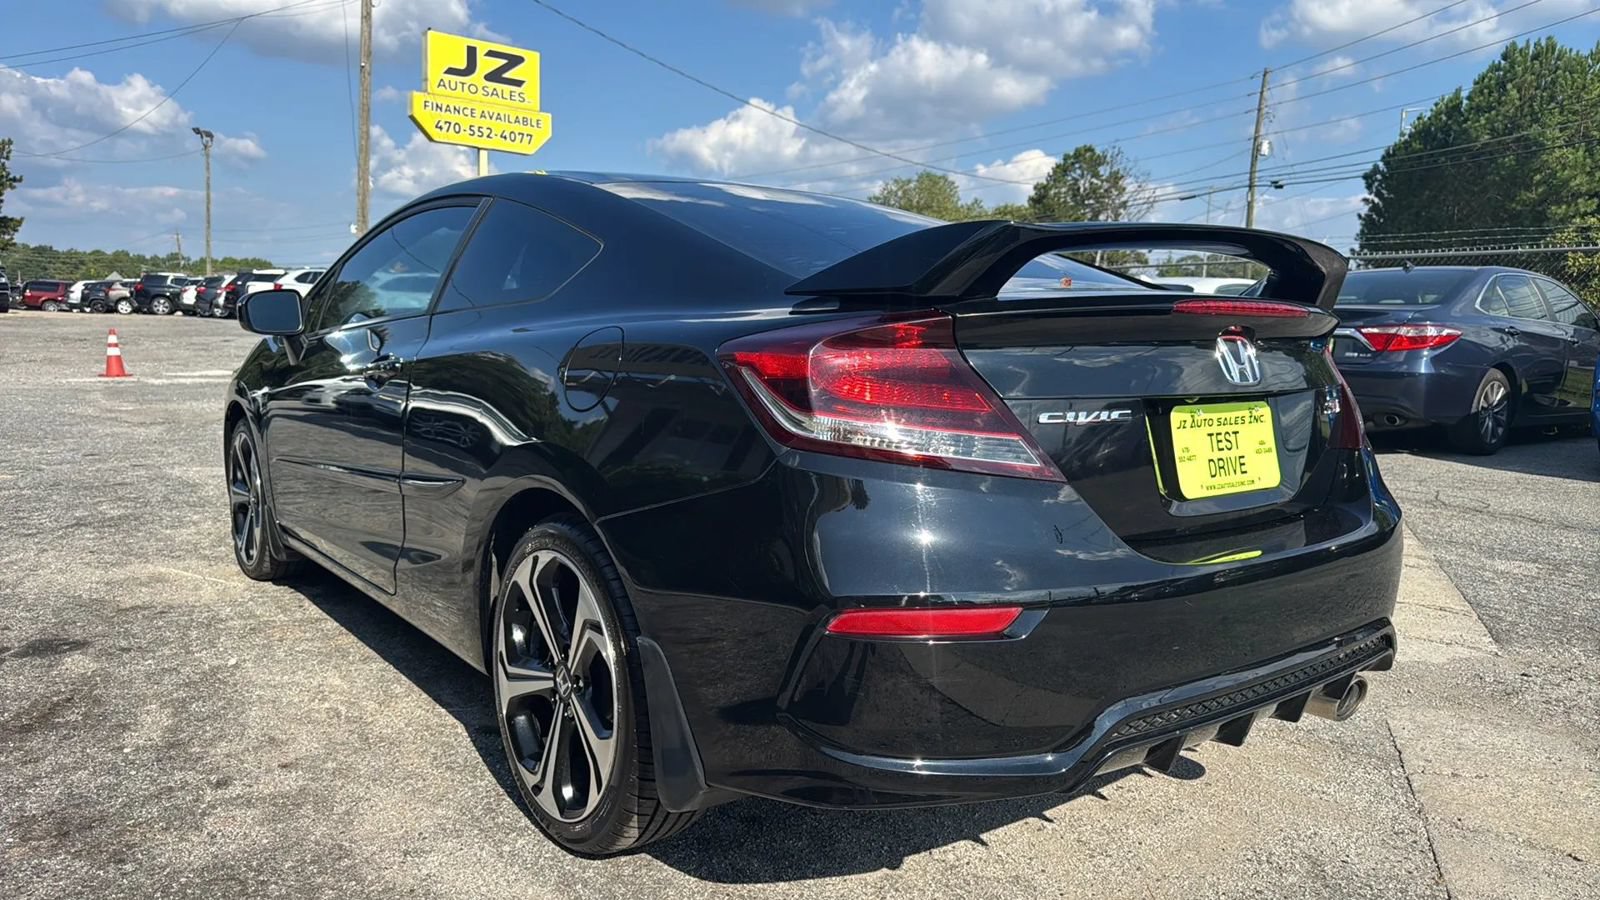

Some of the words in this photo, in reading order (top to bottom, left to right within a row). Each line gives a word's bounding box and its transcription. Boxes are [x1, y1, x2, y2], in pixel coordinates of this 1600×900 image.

[443, 45, 526, 88] JZ
[437, 78, 478, 95] AUTO
[481, 86, 526, 103] SALES
[423, 100, 476, 118] FINANCE
[480, 110, 542, 129] AVAILABLE
[435, 119, 533, 145] 470-552-4077
[1038, 410, 1132, 426] CIVIC
[1176, 420, 1187, 430] JZ
[1190, 415, 1214, 429] AUTO
[1216, 415, 1246, 427] SALES
[1207, 431, 1240, 453] TEST
[1208, 455, 1248, 478] DRIVE
